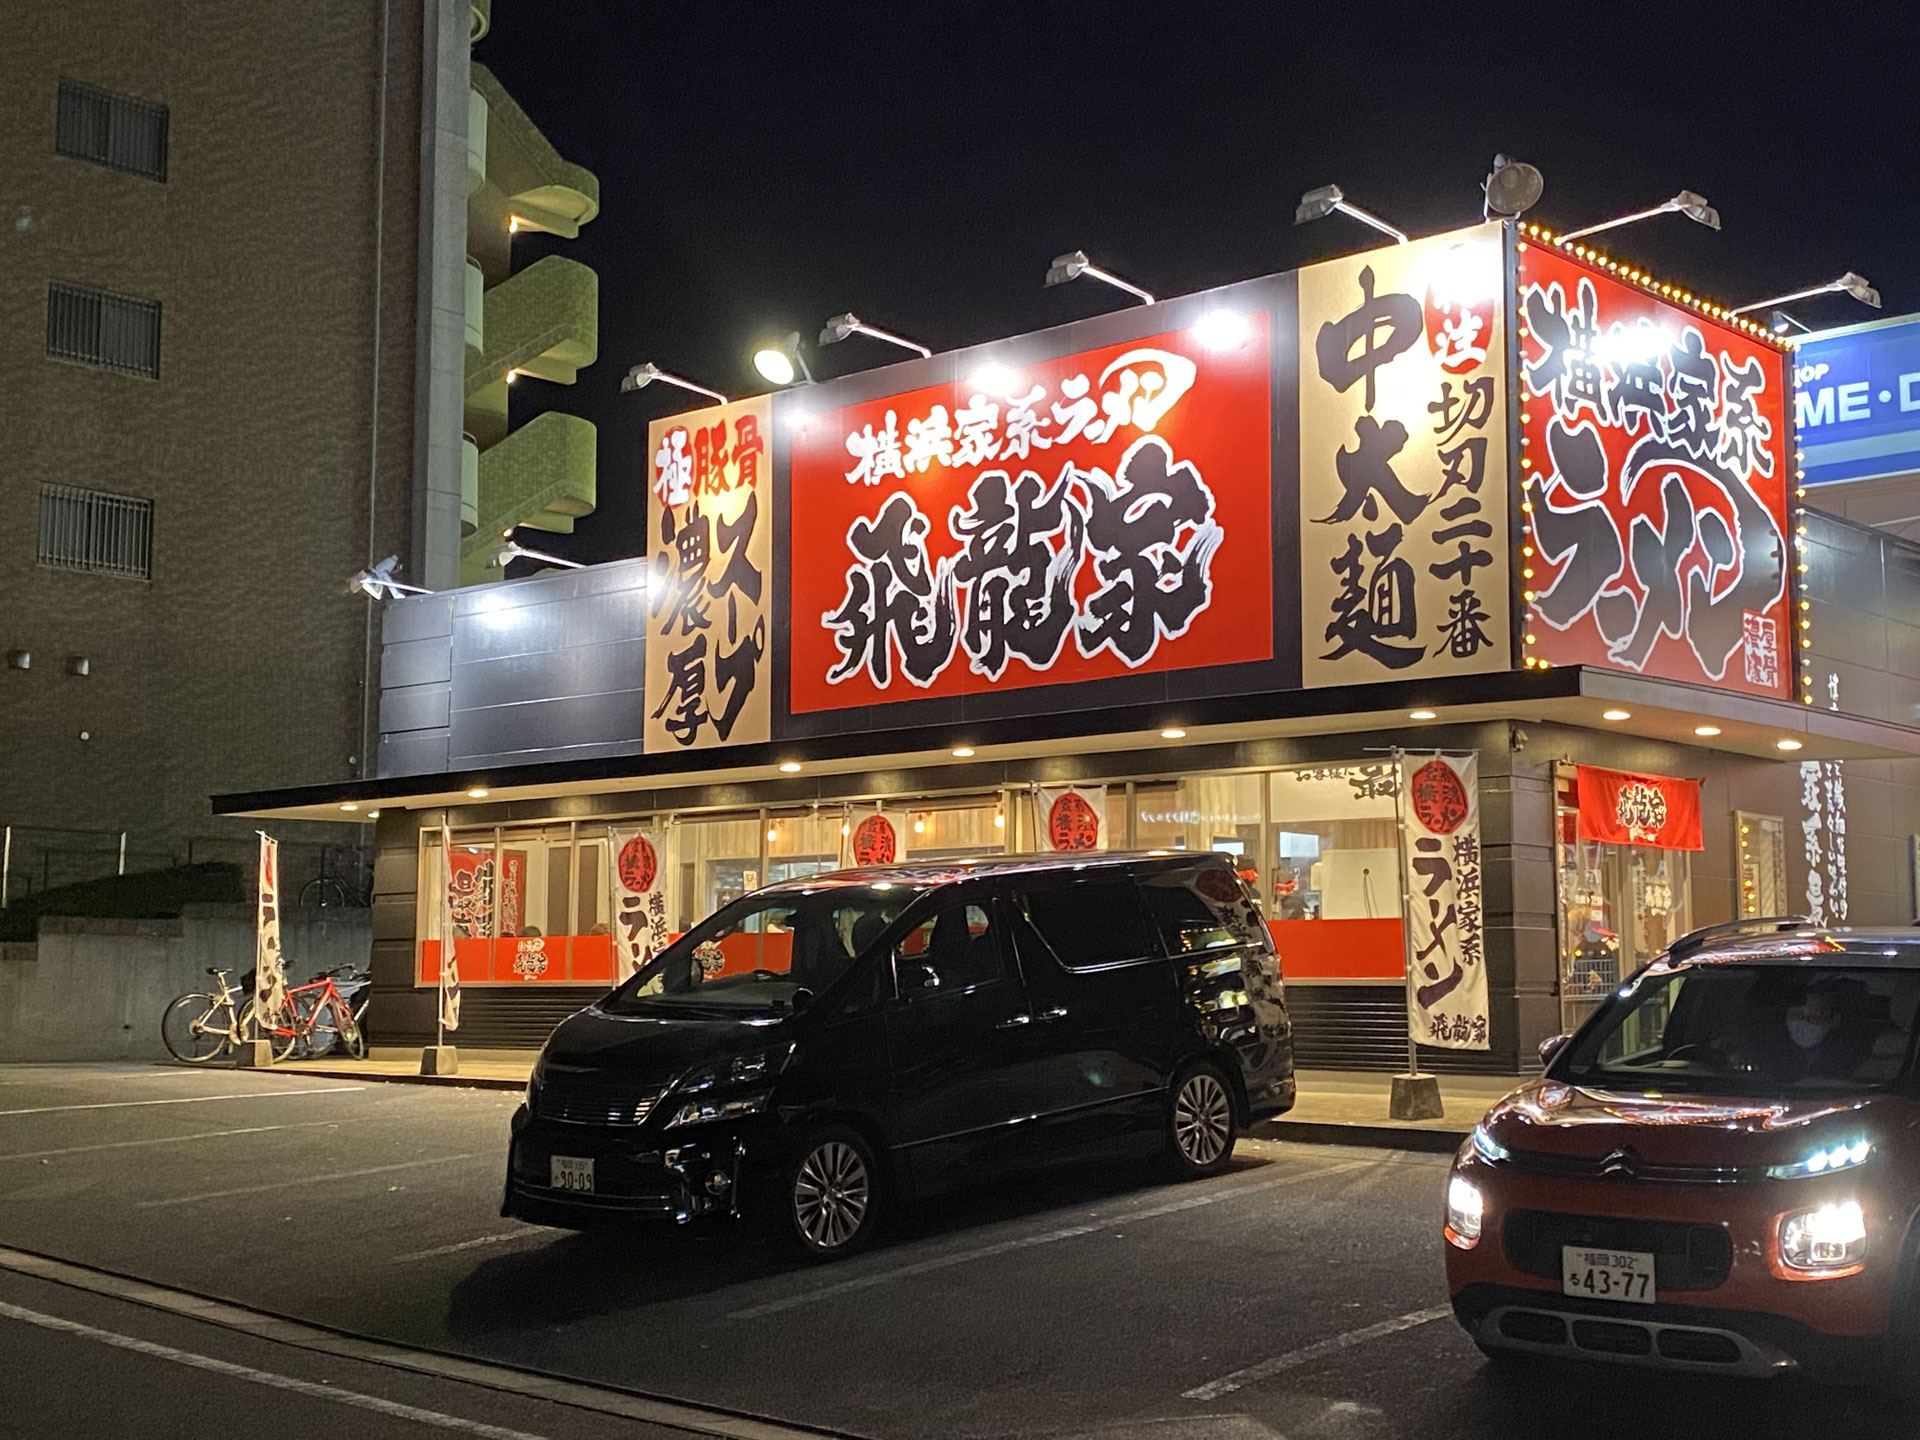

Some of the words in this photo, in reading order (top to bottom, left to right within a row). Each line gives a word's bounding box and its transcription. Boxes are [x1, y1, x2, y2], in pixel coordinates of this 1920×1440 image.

[822, 435, 1223, 688] 飛龍家
[1310, 265, 1432, 669] 中太麺
[1427, 376, 1494, 659] 切刃二十番
[651, 500, 714, 746] 濃厚
[707, 490, 764, 743] スープ
[648, 891, 668, 954] 横浜
[1412, 837, 1464, 1010] ラーメン
[1452, 835, 1482, 966] 横浜家系
[1583, 1269, 1650, 1299] 43-77
